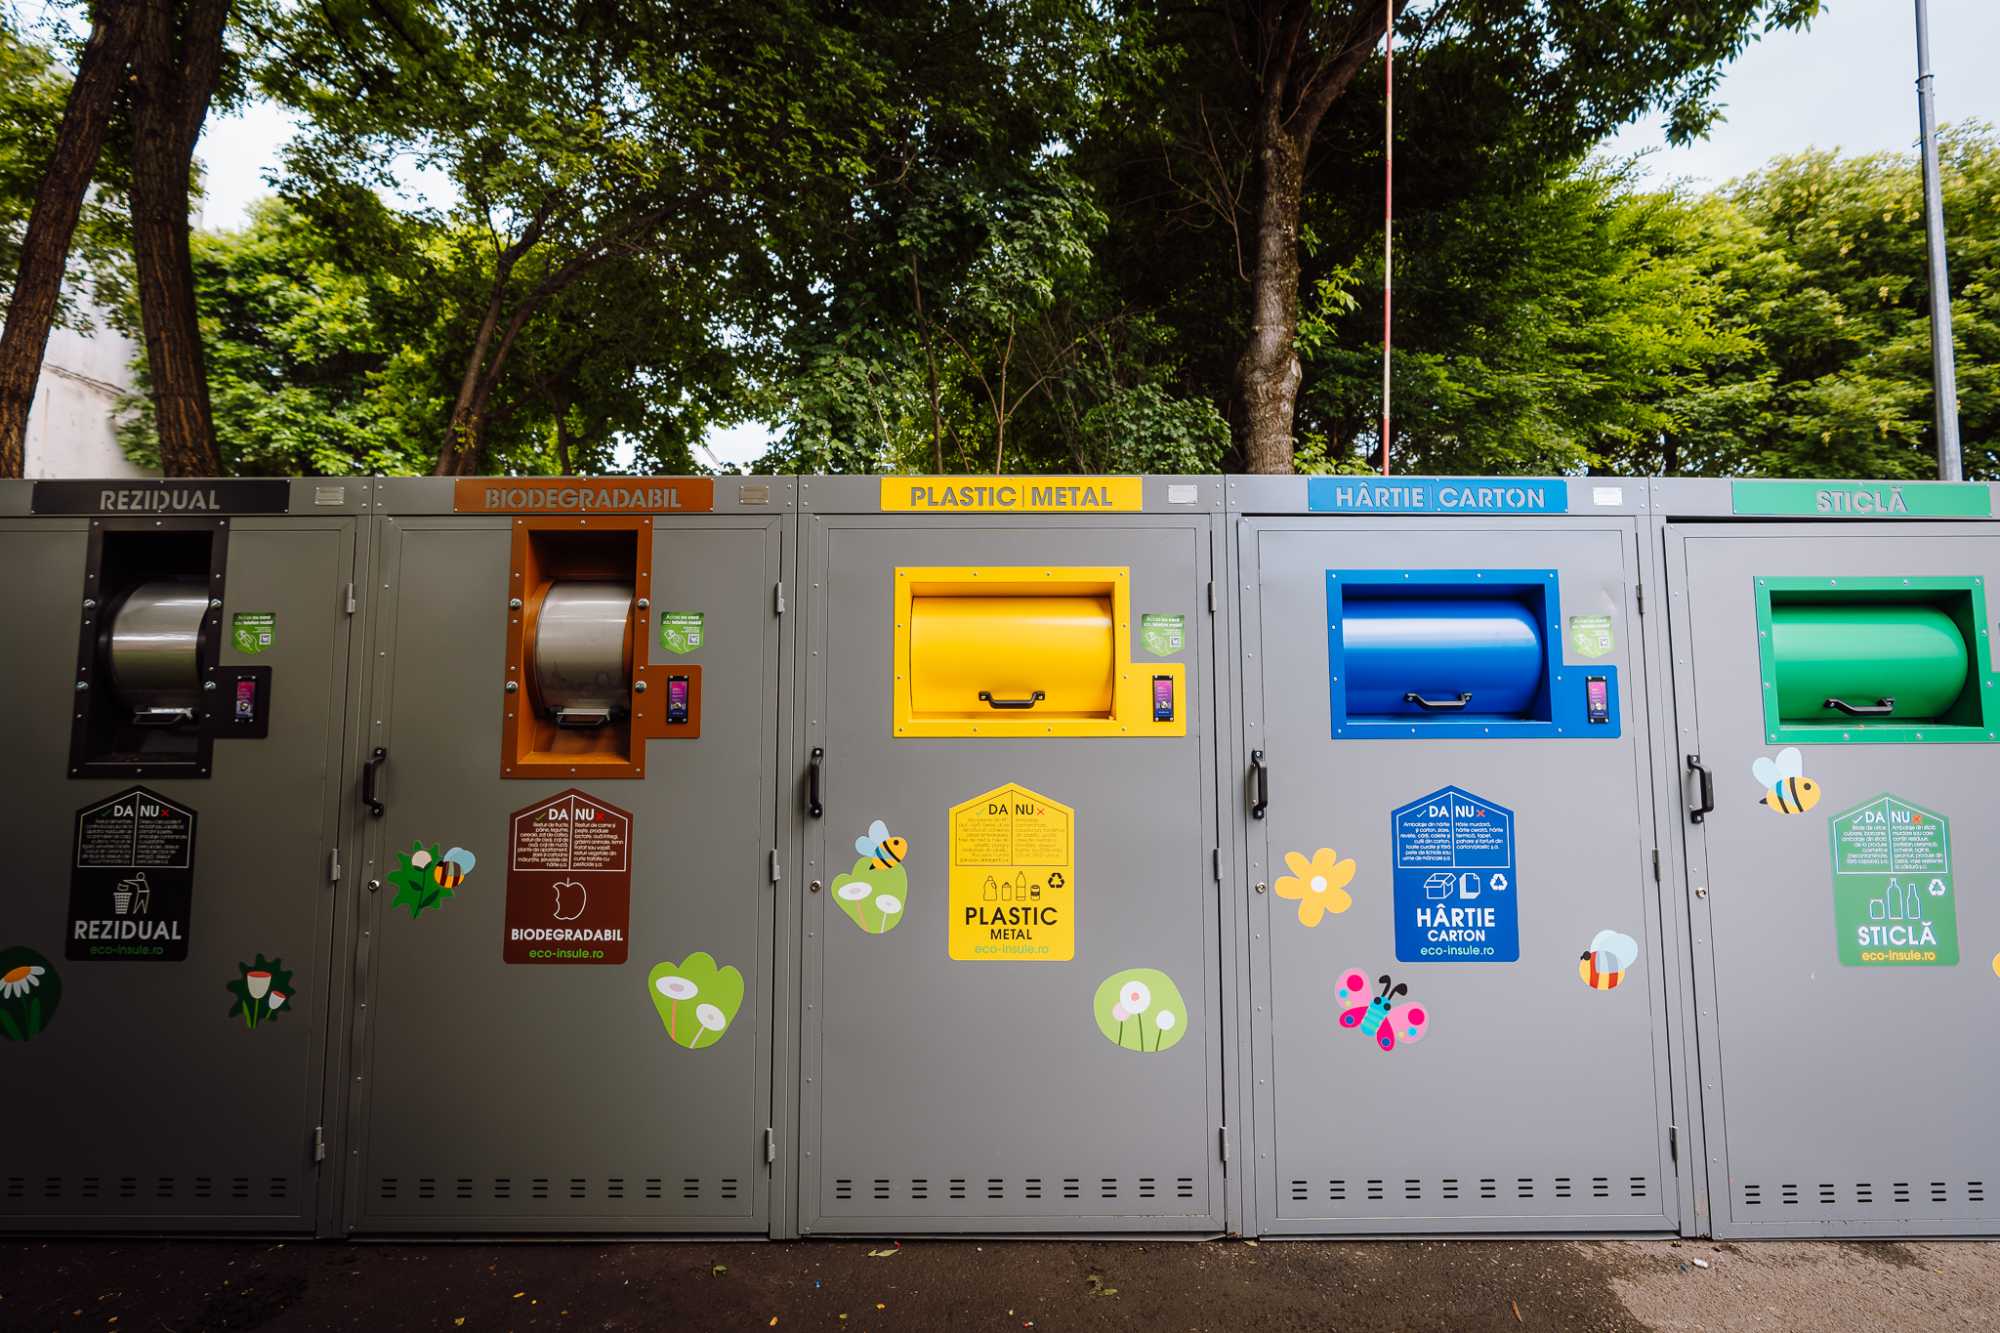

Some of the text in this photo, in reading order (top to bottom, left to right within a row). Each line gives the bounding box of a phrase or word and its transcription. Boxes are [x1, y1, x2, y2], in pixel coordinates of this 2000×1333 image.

[100, 490, 220, 510] REZIDUAL
[485, 488, 681, 509] BIODEGRADABIL
[911, 486, 1113, 506] PLASTIC METAL
[1336, 481, 1545, 508] HÂRTIE CARTON
[1816, 484, 1909, 512] STICLĂ
[114, 805, 133, 817] DA
[140, 805, 159, 817] NU
[549, 809, 568, 820] DA
[575, 809, 594, 820] NU
[988, 804, 1008, 815] DA
[1015, 804, 1034, 815] NU
[1429, 805, 1449, 817] DA
[1455, 805, 1474, 817] NU
[1865, 812, 1885, 823] DA
[1892, 812, 1910, 823] NU
[965, 907, 1058, 925] PLASTIC
[1416, 903, 1496, 927] HÂRTIE
[74, 920, 182, 940] REZIDUAL
[511, 929, 623, 941] BIODEGRADABIL
[990, 929, 1032, 940] METAL
[1427, 930, 1486, 942] CARTON
[1857, 921, 1937, 946] STICLĂ
[90, 945, 164, 955] eco-insule.ro
[528, 948, 604, 959] eco-insule.ro
[974, 944, 1049, 954] eco-insule.ro
[1420, 945, 1495, 956] eco-insule.ro
[1862, 950, 1936, 961] eco-insule.ro
